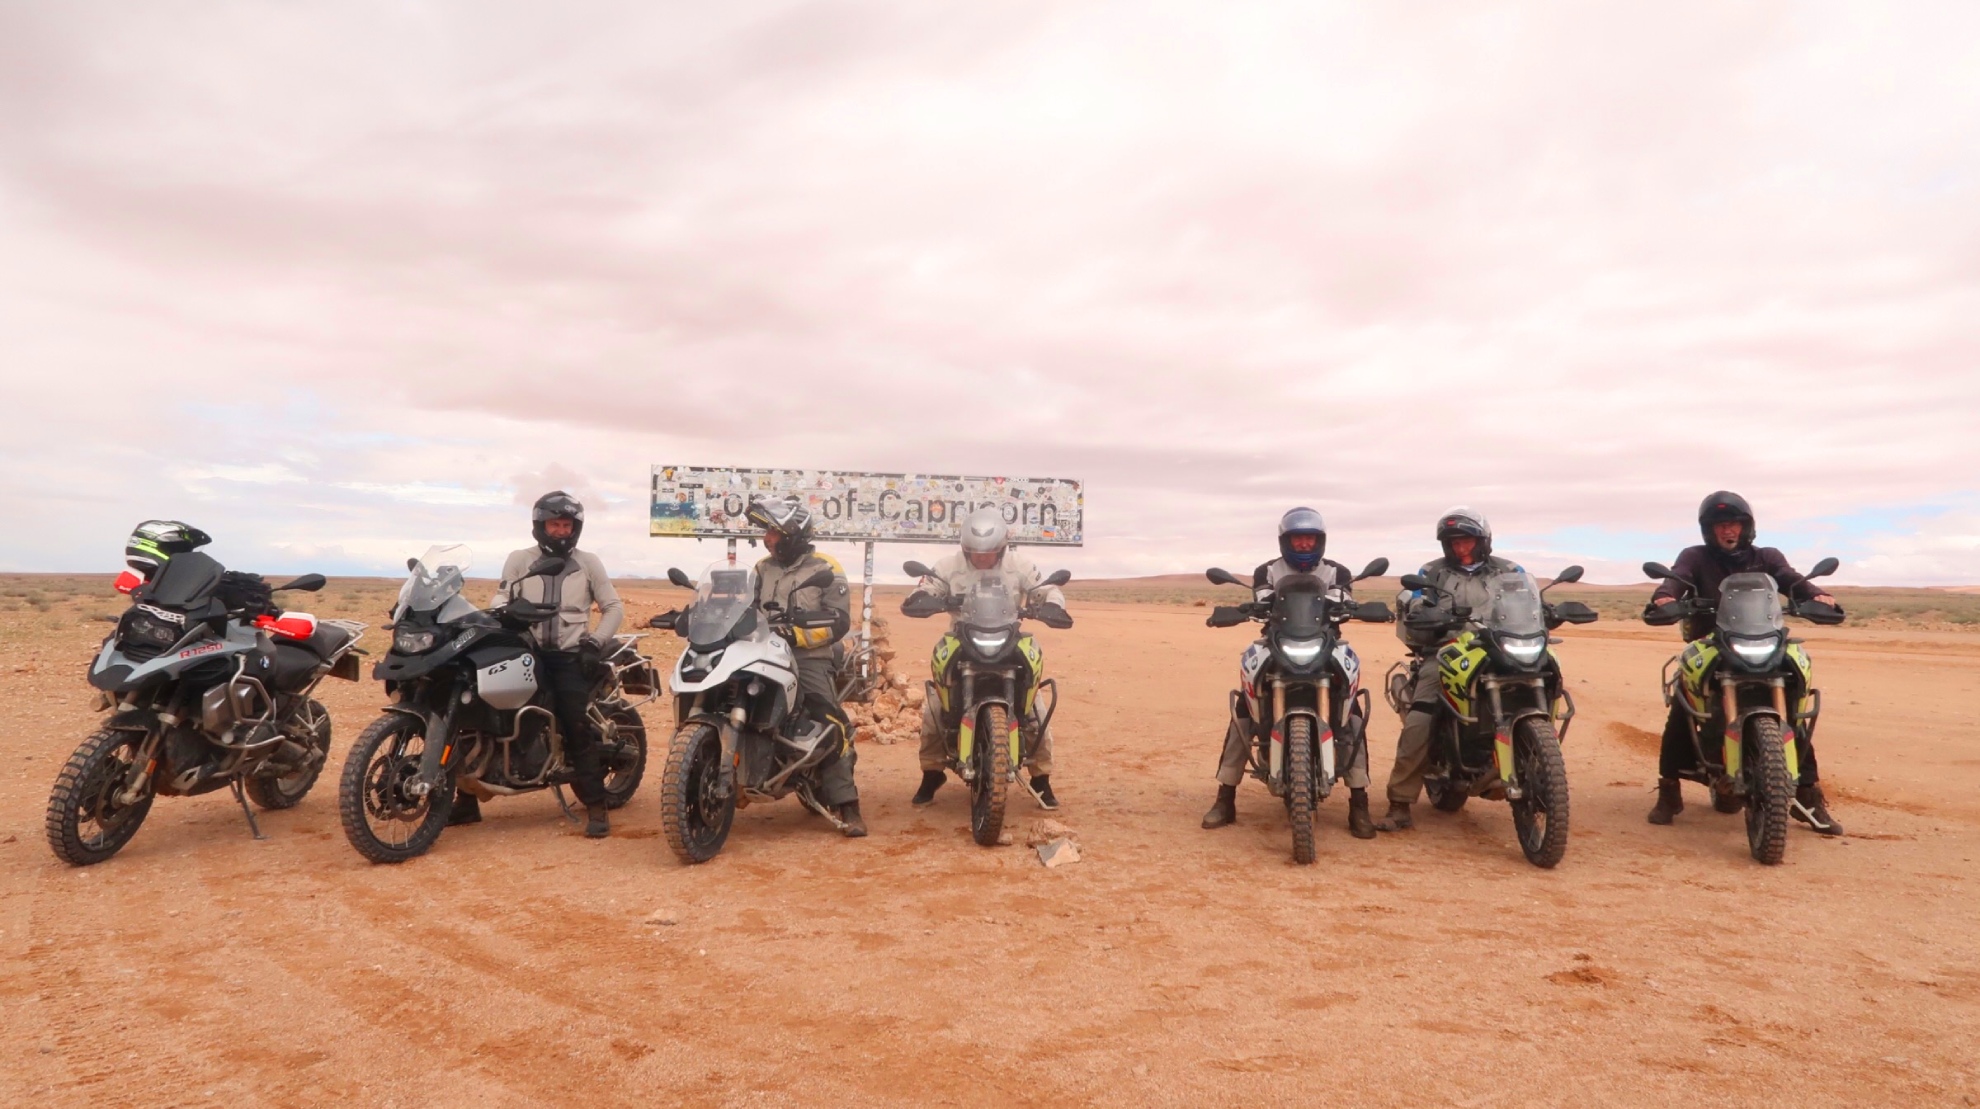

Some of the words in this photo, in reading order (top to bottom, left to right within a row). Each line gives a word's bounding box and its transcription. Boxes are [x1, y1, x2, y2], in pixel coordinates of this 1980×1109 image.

[823, 488, 858, 520] of
[180, 650, 190, 659] R
[192, 643, 223, 656] 1250
[488, 662, 508, 676] GS
